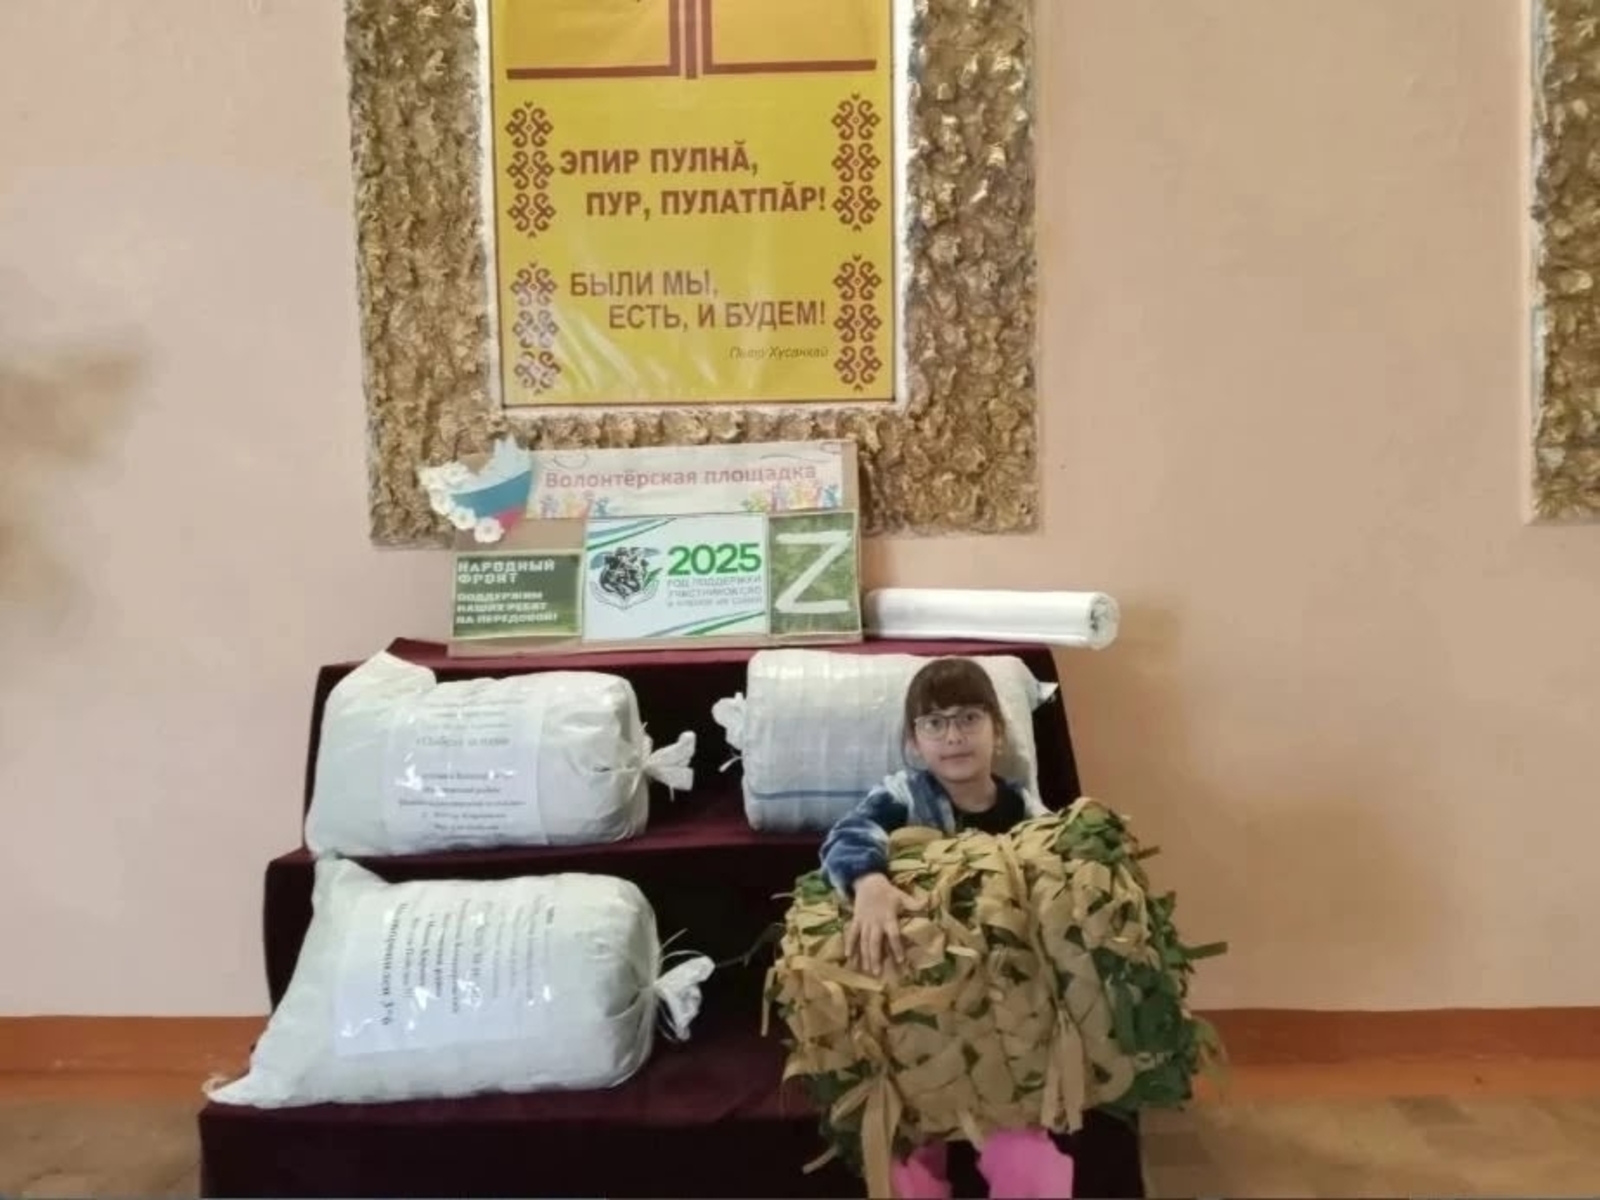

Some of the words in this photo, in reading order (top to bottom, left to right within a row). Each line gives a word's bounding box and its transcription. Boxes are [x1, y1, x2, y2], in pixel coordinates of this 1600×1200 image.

[559, 148, 639, 175] ЭПИР
[650, 140, 758, 177] ПУЛНӐ,
[585, 191, 651, 221] ПУР,
[660, 181, 826, 216] ПУЛАТПӐР!
[569, 271, 653, 297] БЫЛИ
[661, 269, 718, 299] МЫ,
[609, 304, 689, 333] ЕСТЬ,
[697, 304, 716, 327] И
[724, 300, 826, 332] БУДЕМ!
[545, 470, 697, 489] Волонтёрская
[704, 465, 817, 485] площадка
[458, 559, 555, 574] НАРОДНЫЙ
[667, 543, 762, 575] 2025
[775, 530, 853, 614] Z
[458, 573, 518, 584] ФРОНТ
[667, 579, 689, 588] ГОД
[693, 576, 761, 587] ПОДДЕРЖКИ
[456, 615, 474, 624] НА
[477, 612, 558, 624] ПЕРЕДОВОЙ!
[457, 603, 504, 612] НАШИХ
[506, 602, 548, 611] РЕБЯТ
